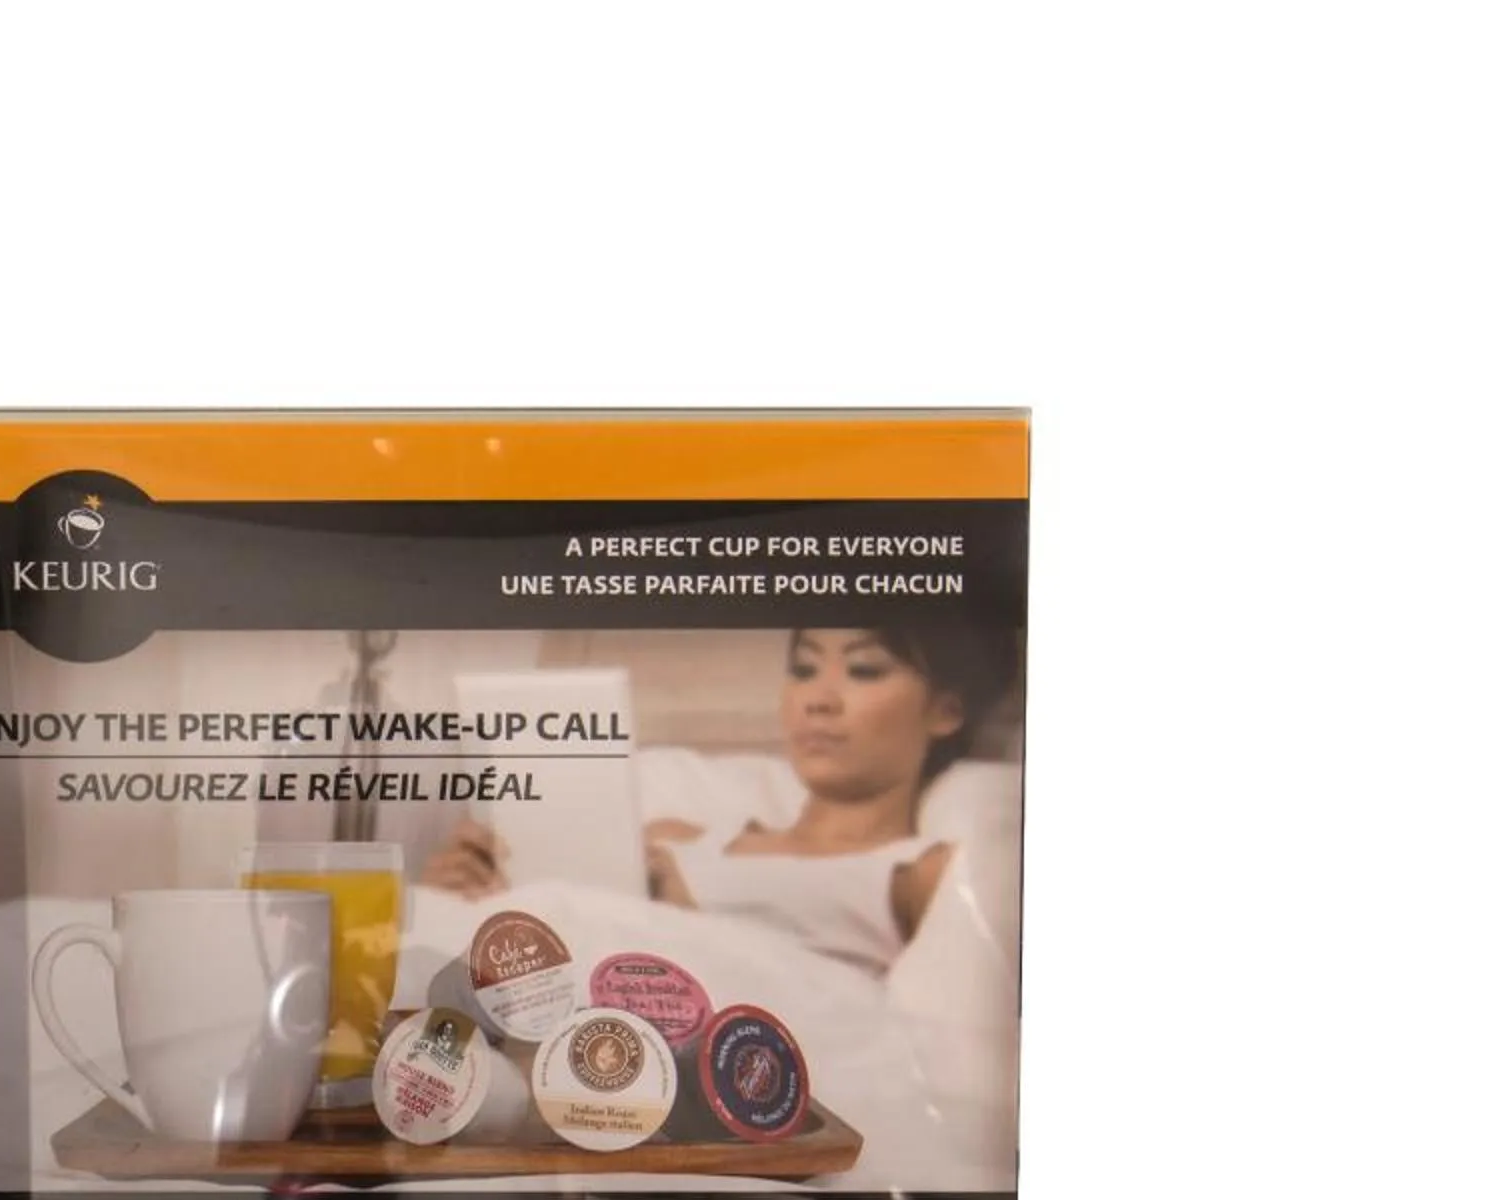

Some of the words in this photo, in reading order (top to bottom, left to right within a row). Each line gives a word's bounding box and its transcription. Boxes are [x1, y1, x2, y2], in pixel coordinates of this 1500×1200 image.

[565, 538, 583, 556] A
[591, 537, 702, 556] PERFECT
[709, 537, 760, 556] CUP
[768, 537, 820, 556] FOR
[828, 536, 964, 556] EVERYONE
[13, 561, 158, 591] KEURIG
[501, 575, 554, 595] UNE
[561, 575, 637, 595] TASSE
[645, 575, 766, 595] PARFAITE
[774, 574, 848, 595] POUR
[854, 574, 964, 595] CHACUN
[95, 713, 167, 741] THE
[179, 713, 340, 741] PERFECT
[349, 713, 526, 742] WAKE-UP
[537, 712, 629, 741] CALL
[57, 773, 248, 801] SAVOUREZ
[258, 773, 299, 800] LE
[308, 766, 428, 800] RÉVEIL
[438, 767, 542, 801] IDÉAL
